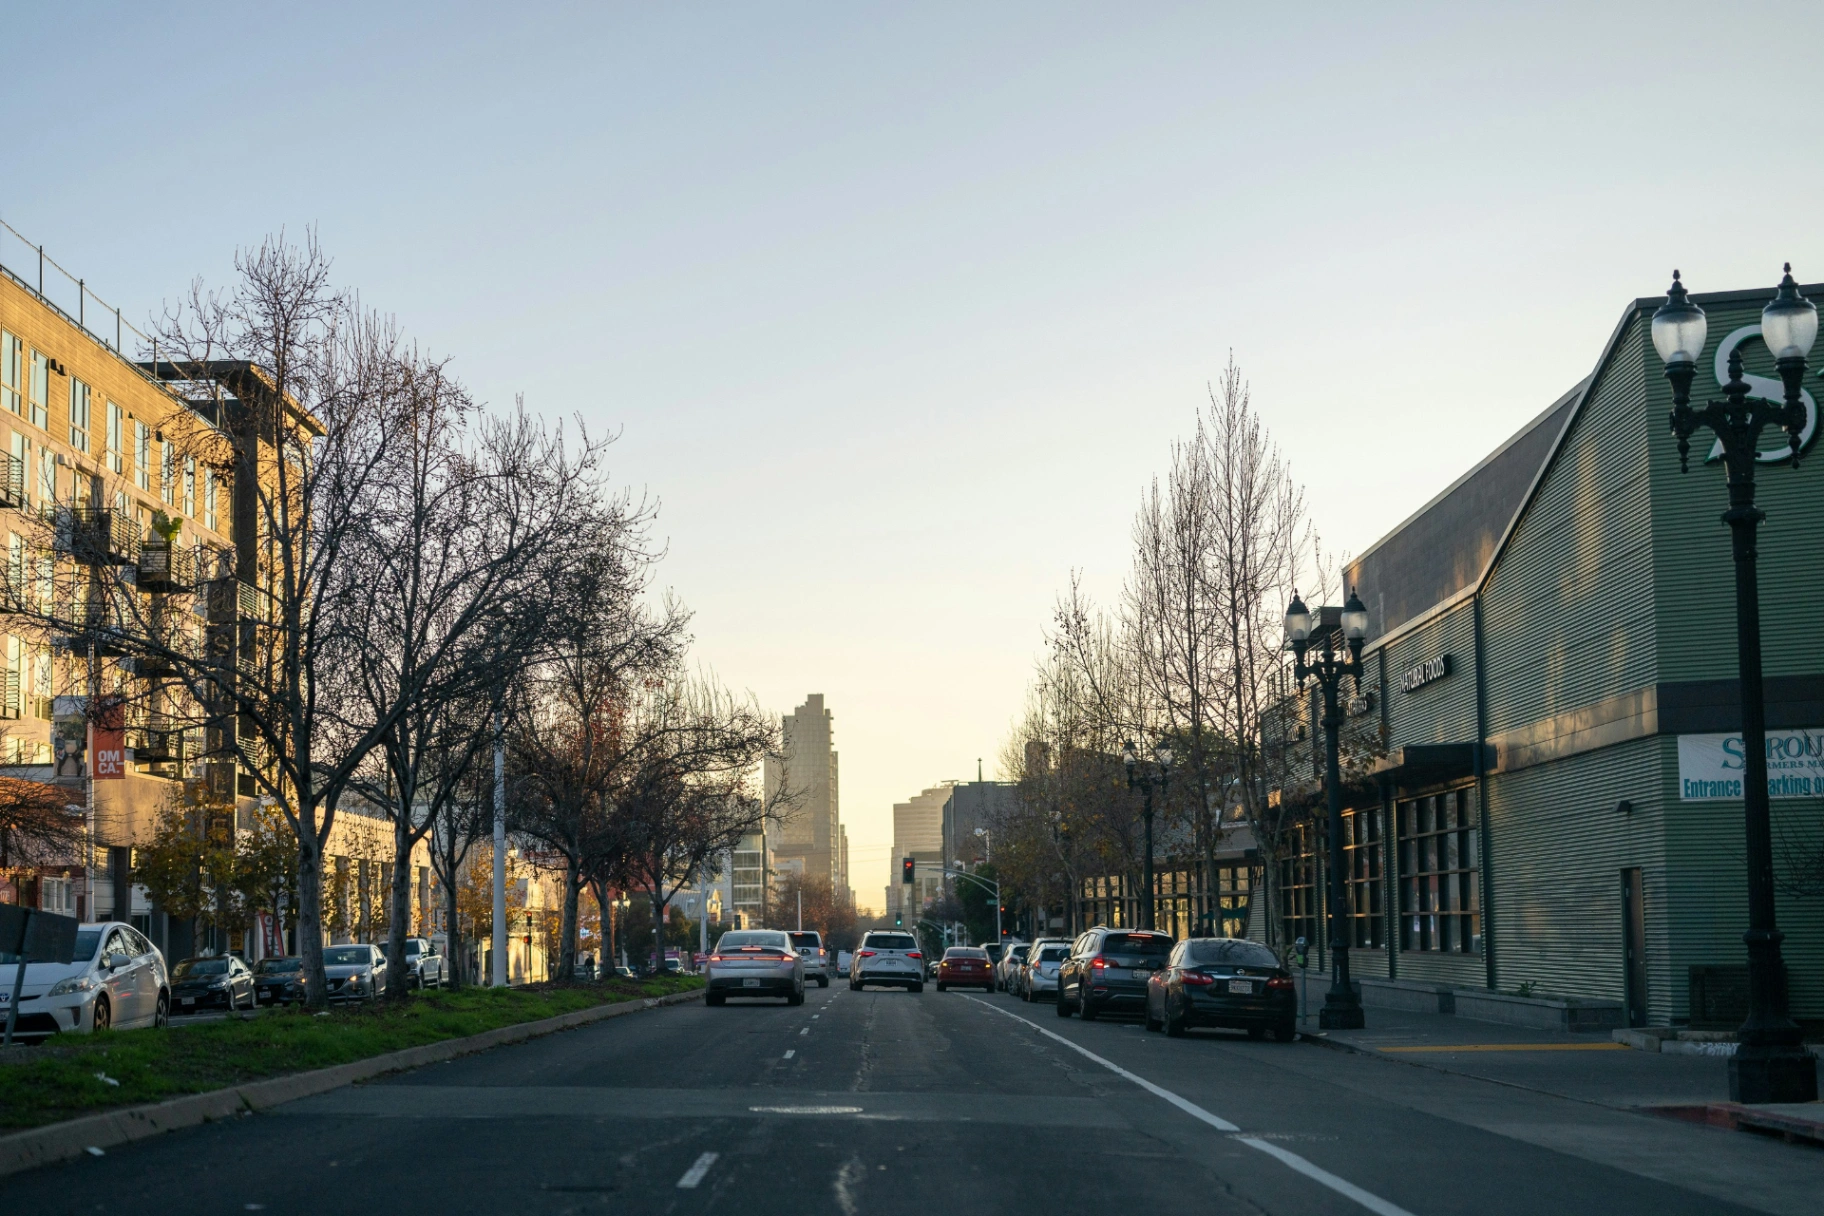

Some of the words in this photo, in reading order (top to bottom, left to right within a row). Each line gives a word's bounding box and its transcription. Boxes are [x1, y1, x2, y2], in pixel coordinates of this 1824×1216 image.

[1425, 654, 1445, 682] FOODS
[98, 750, 119, 762] OM
[1721, 735, 1824, 769] SROU
[1767, 761, 1804, 769] RMERS
[1684, 778, 1741, 797] Entrance
[1768, 774, 1811, 796] arking
